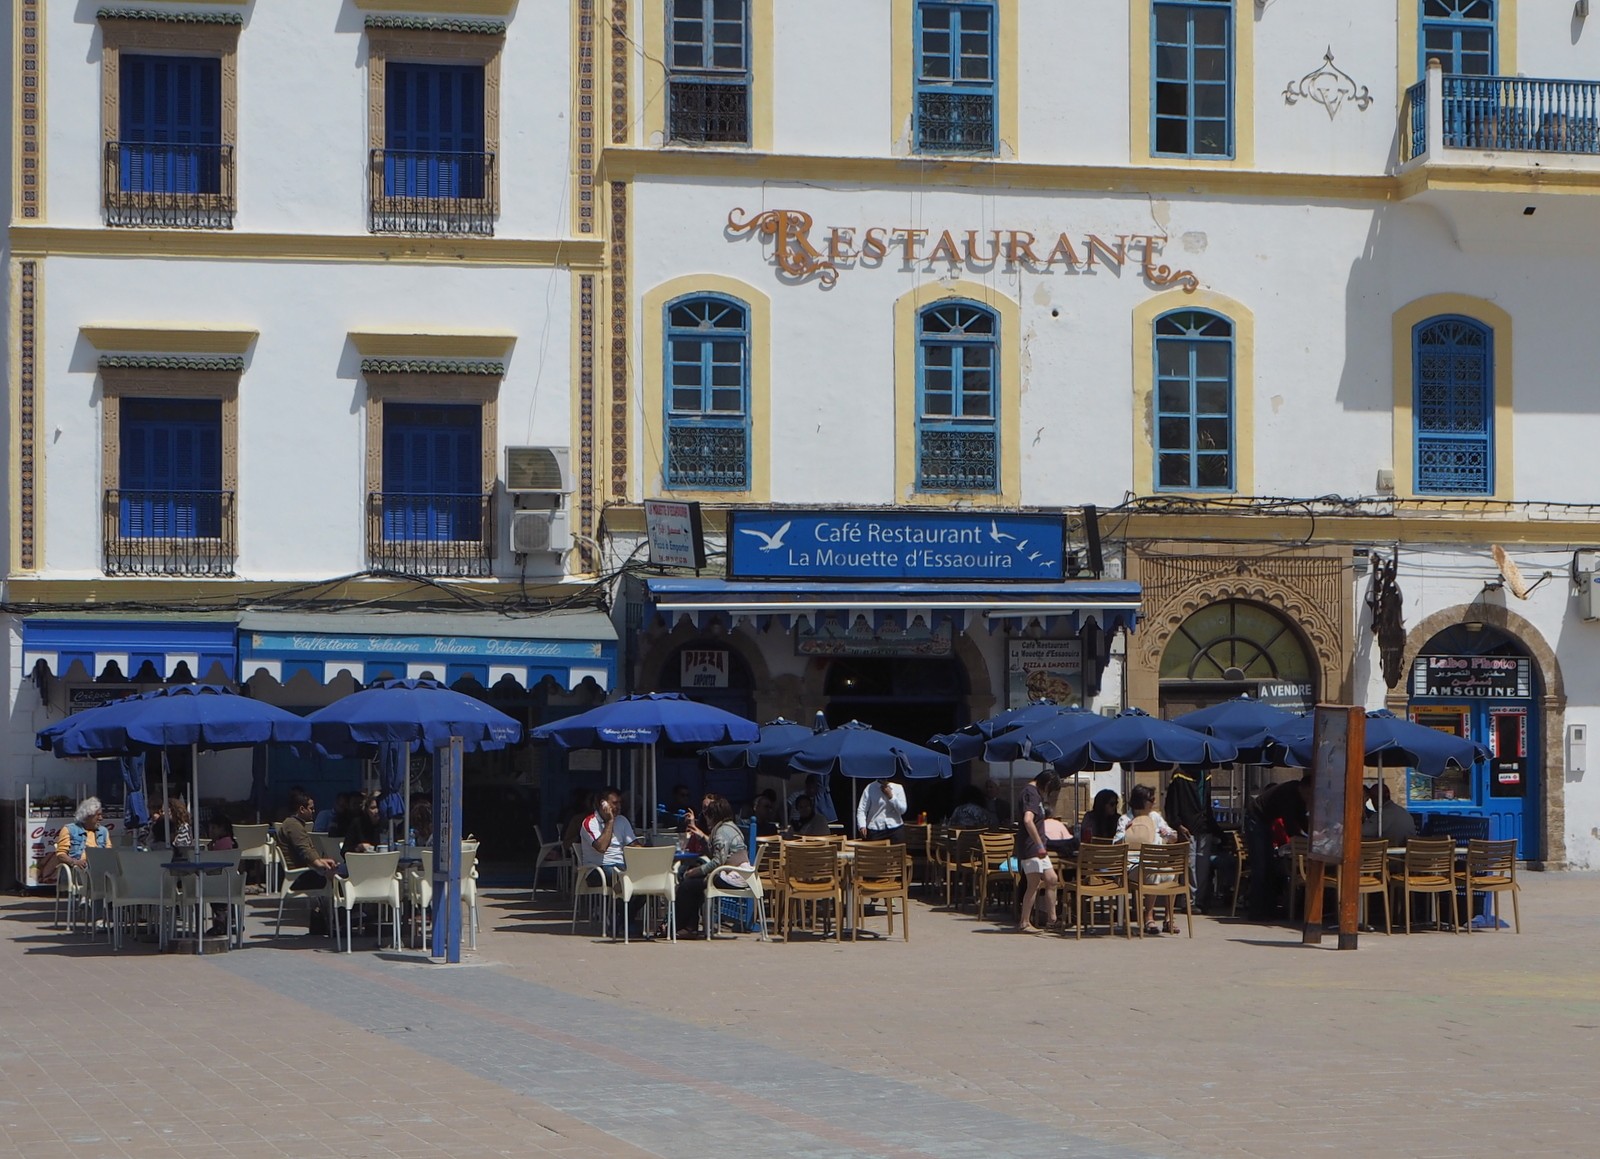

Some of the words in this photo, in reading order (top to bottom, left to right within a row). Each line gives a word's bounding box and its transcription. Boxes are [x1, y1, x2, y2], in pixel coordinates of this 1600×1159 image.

[727, 207, 1198, 294] RESTAURANT
[814, 522, 861, 543] Café
[868, 523, 982, 544] Restaurant
[788, 549, 809, 566] La
[816, 549, 898, 567] Mouette
[905, 549, 1012, 568] d'Essaouira
[292, 634, 359, 650] Caffetteria
[367, 635, 420, 651] Gelateria
[429, 637, 476, 653] Italiana
[1037, 641, 1070, 649] Restaurant
[685, 651, 724, 672] PIZZA
[1429, 657, 1467, 669] Labo
[1471, 657, 1517, 670] Photo
[1270, 684, 1312, 697] VENDRE
[1428, 686, 1516, 696] AMSGUINE
